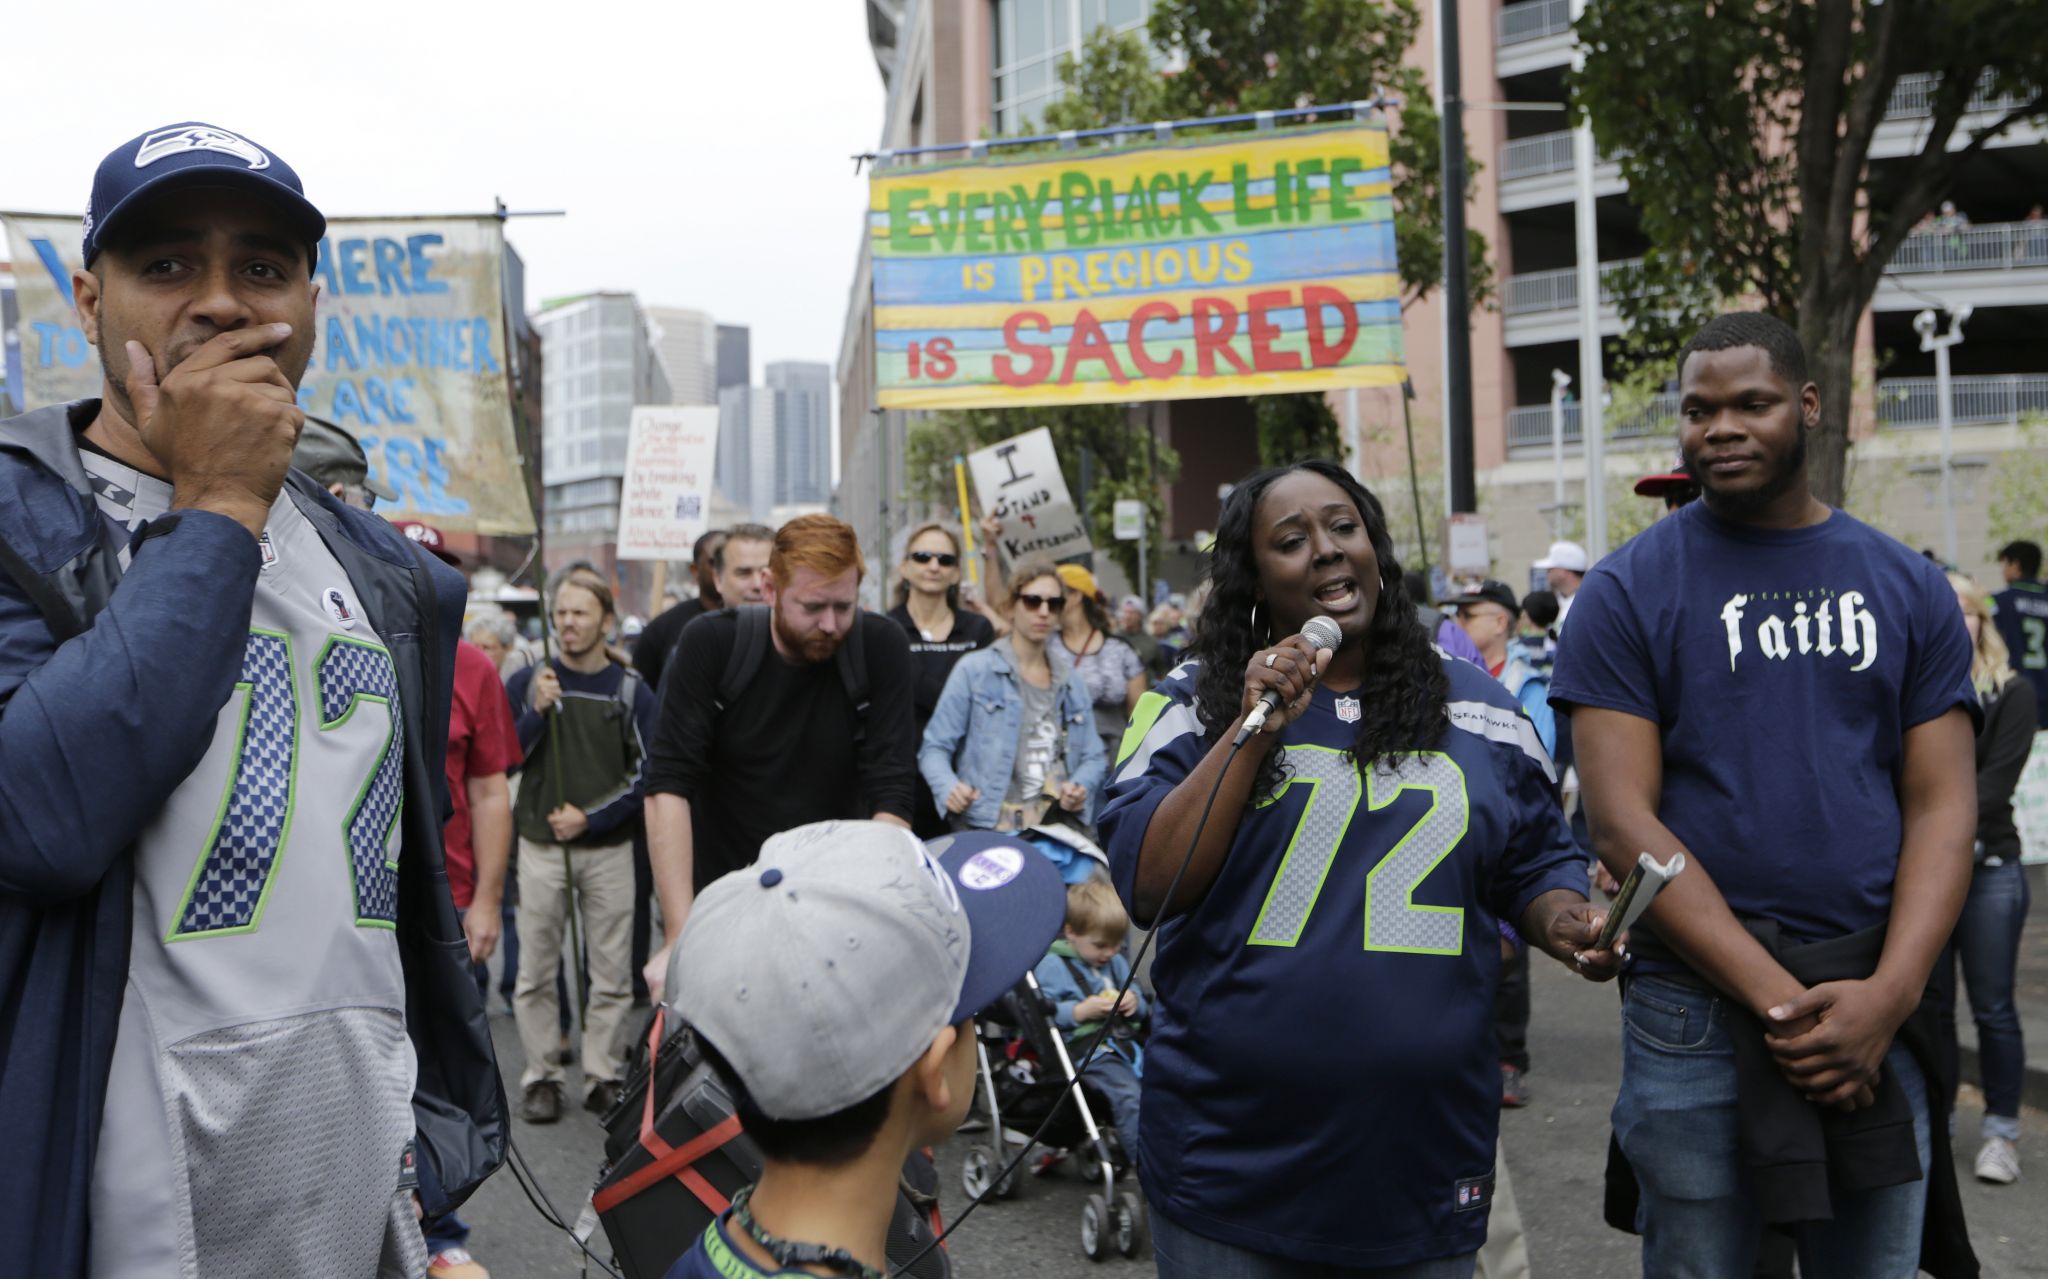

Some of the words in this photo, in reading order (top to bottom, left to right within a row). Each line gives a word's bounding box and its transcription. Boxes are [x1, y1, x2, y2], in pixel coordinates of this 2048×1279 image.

[888, 179, 1051, 254] EVERY
[1060, 170, 1226, 247] BLACK
[1231, 157, 1363, 227] LIFE
[962, 262, 995, 291] IS
[1020, 241, 1254, 301] PRECIOUS
[325, 313, 501, 376] ANOTHER
[907, 336, 957, 380] IS
[992, 286, 1360, 388] SACRED
[331, 375, 417, 425] ARE
[996, 443, 1035, 488] I
[2022, 616, 2047, 670] 3
[1452, 712, 1519, 731] SEAHAWKS
[163, 627, 404, 944] 72
[1246, 743, 1470, 957] 72
